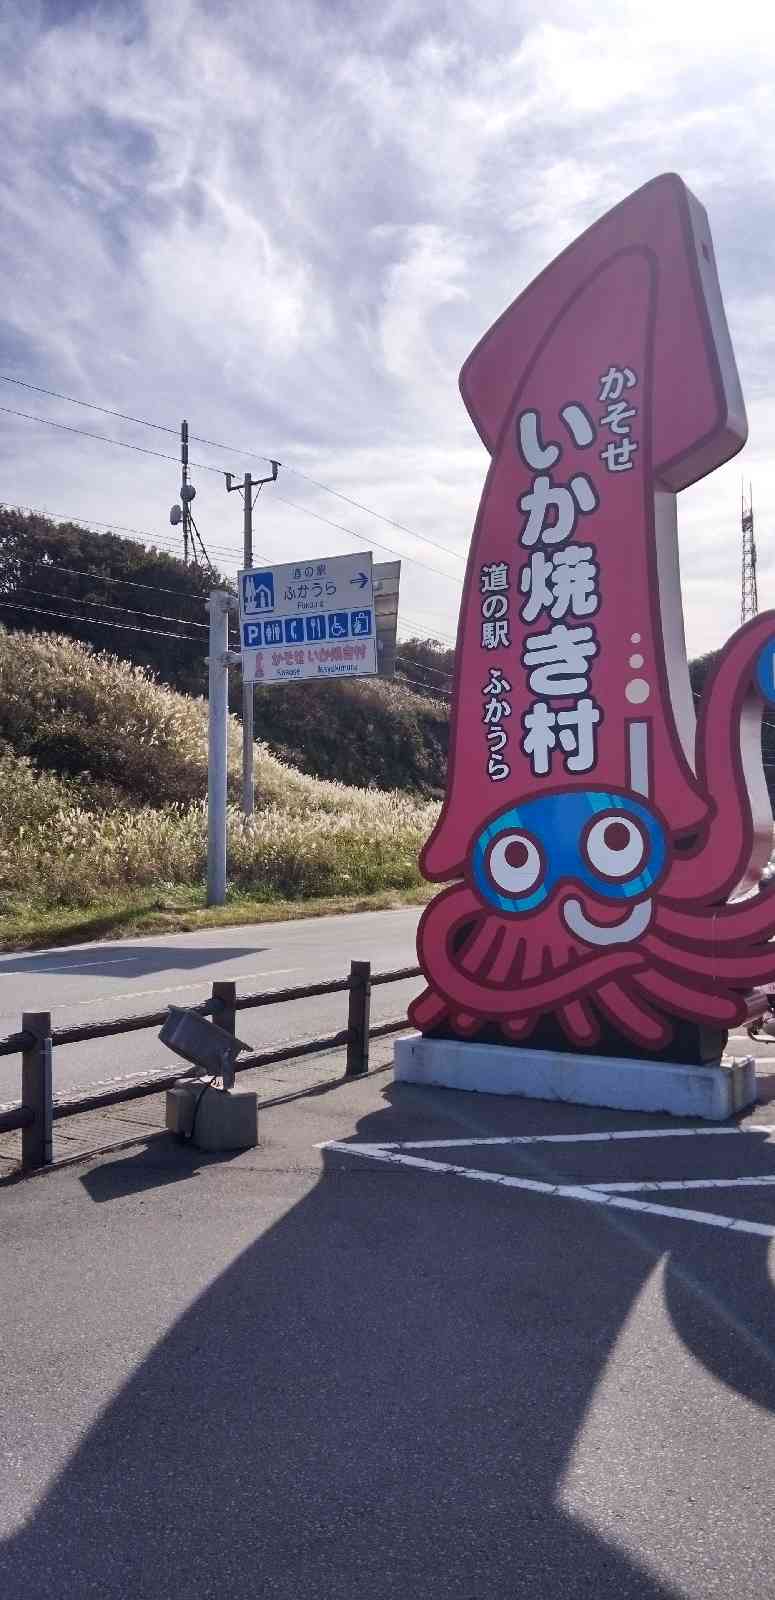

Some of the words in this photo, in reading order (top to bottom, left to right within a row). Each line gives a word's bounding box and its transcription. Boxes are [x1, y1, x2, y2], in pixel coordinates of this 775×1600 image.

[599, 367, 637, 472] かそせ
[284, 582, 337, 600] ふかうら
[481, 563, 509, 650] 道の駅
[519, 404, 599, 774] いか焼き村
[482, 669, 512, 782] ふかうら
